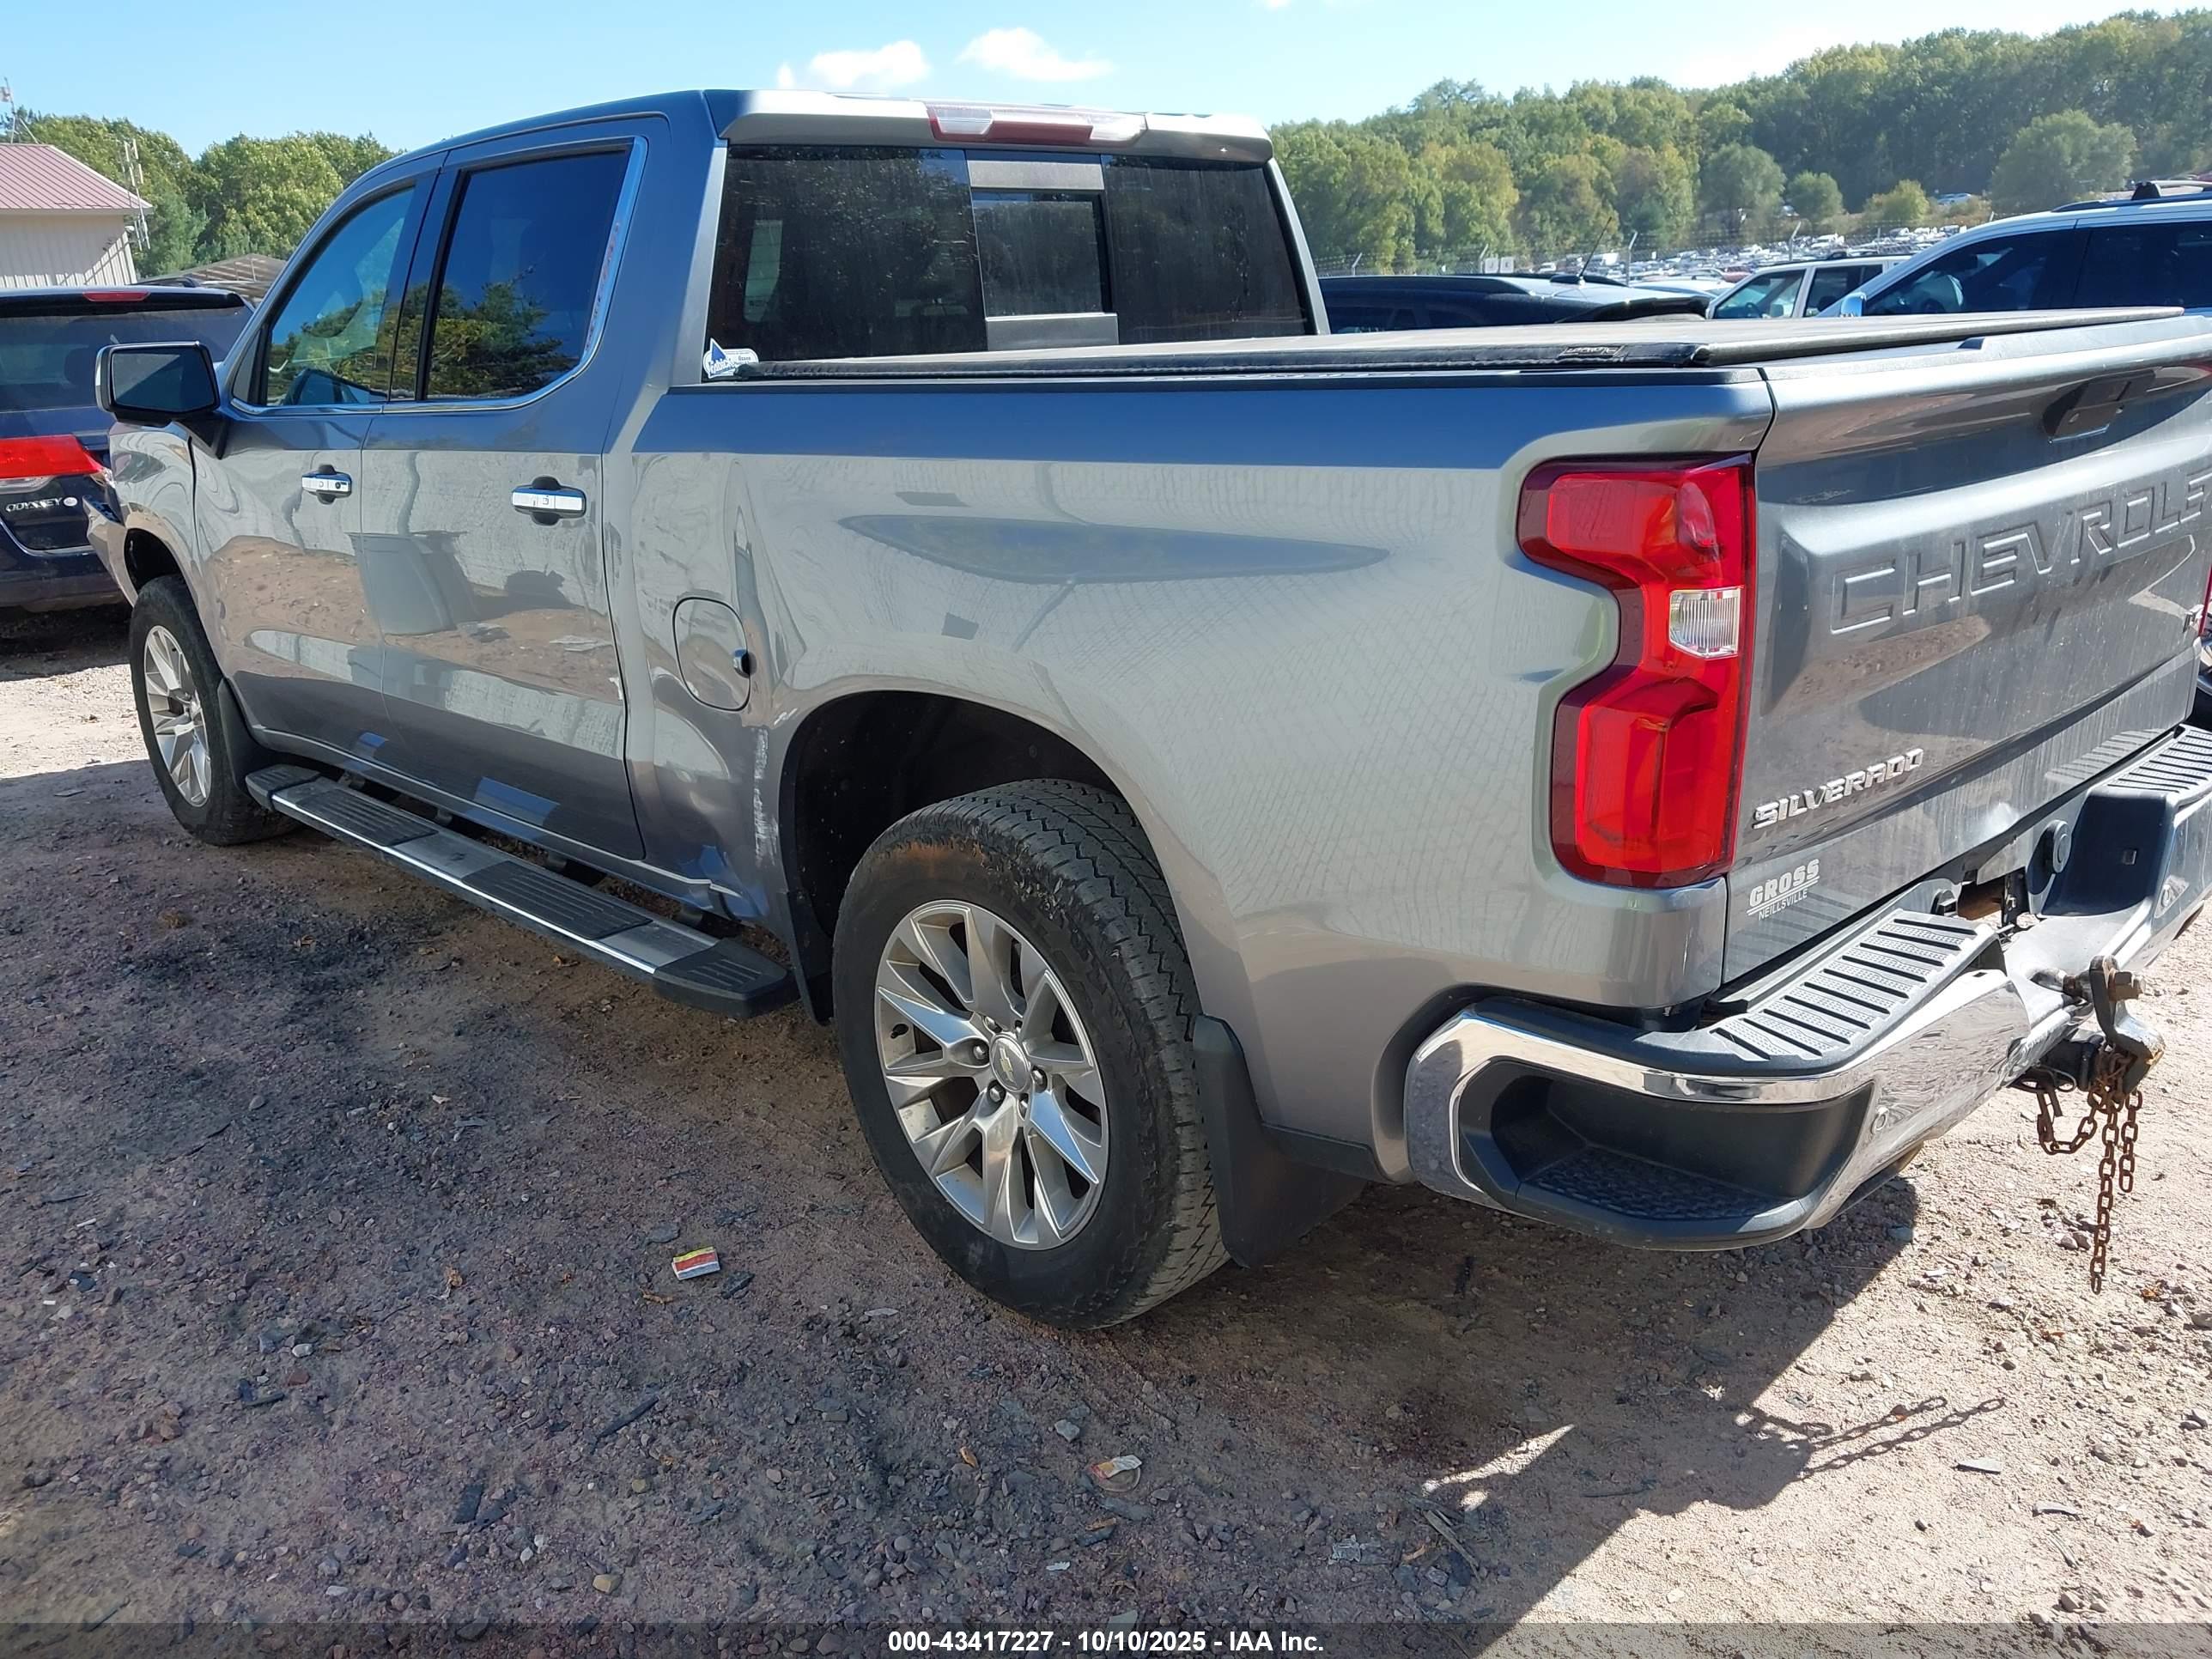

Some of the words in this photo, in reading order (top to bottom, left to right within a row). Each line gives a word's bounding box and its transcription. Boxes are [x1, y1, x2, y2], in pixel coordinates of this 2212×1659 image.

[1830, 467, 2212, 635] CHEVROLE
[1752, 748, 1923, 830] SILVERADO
[1749, 859, 1820, 907] GROSS
[1759, 888, 1808, 921] NEILLSVILLE
